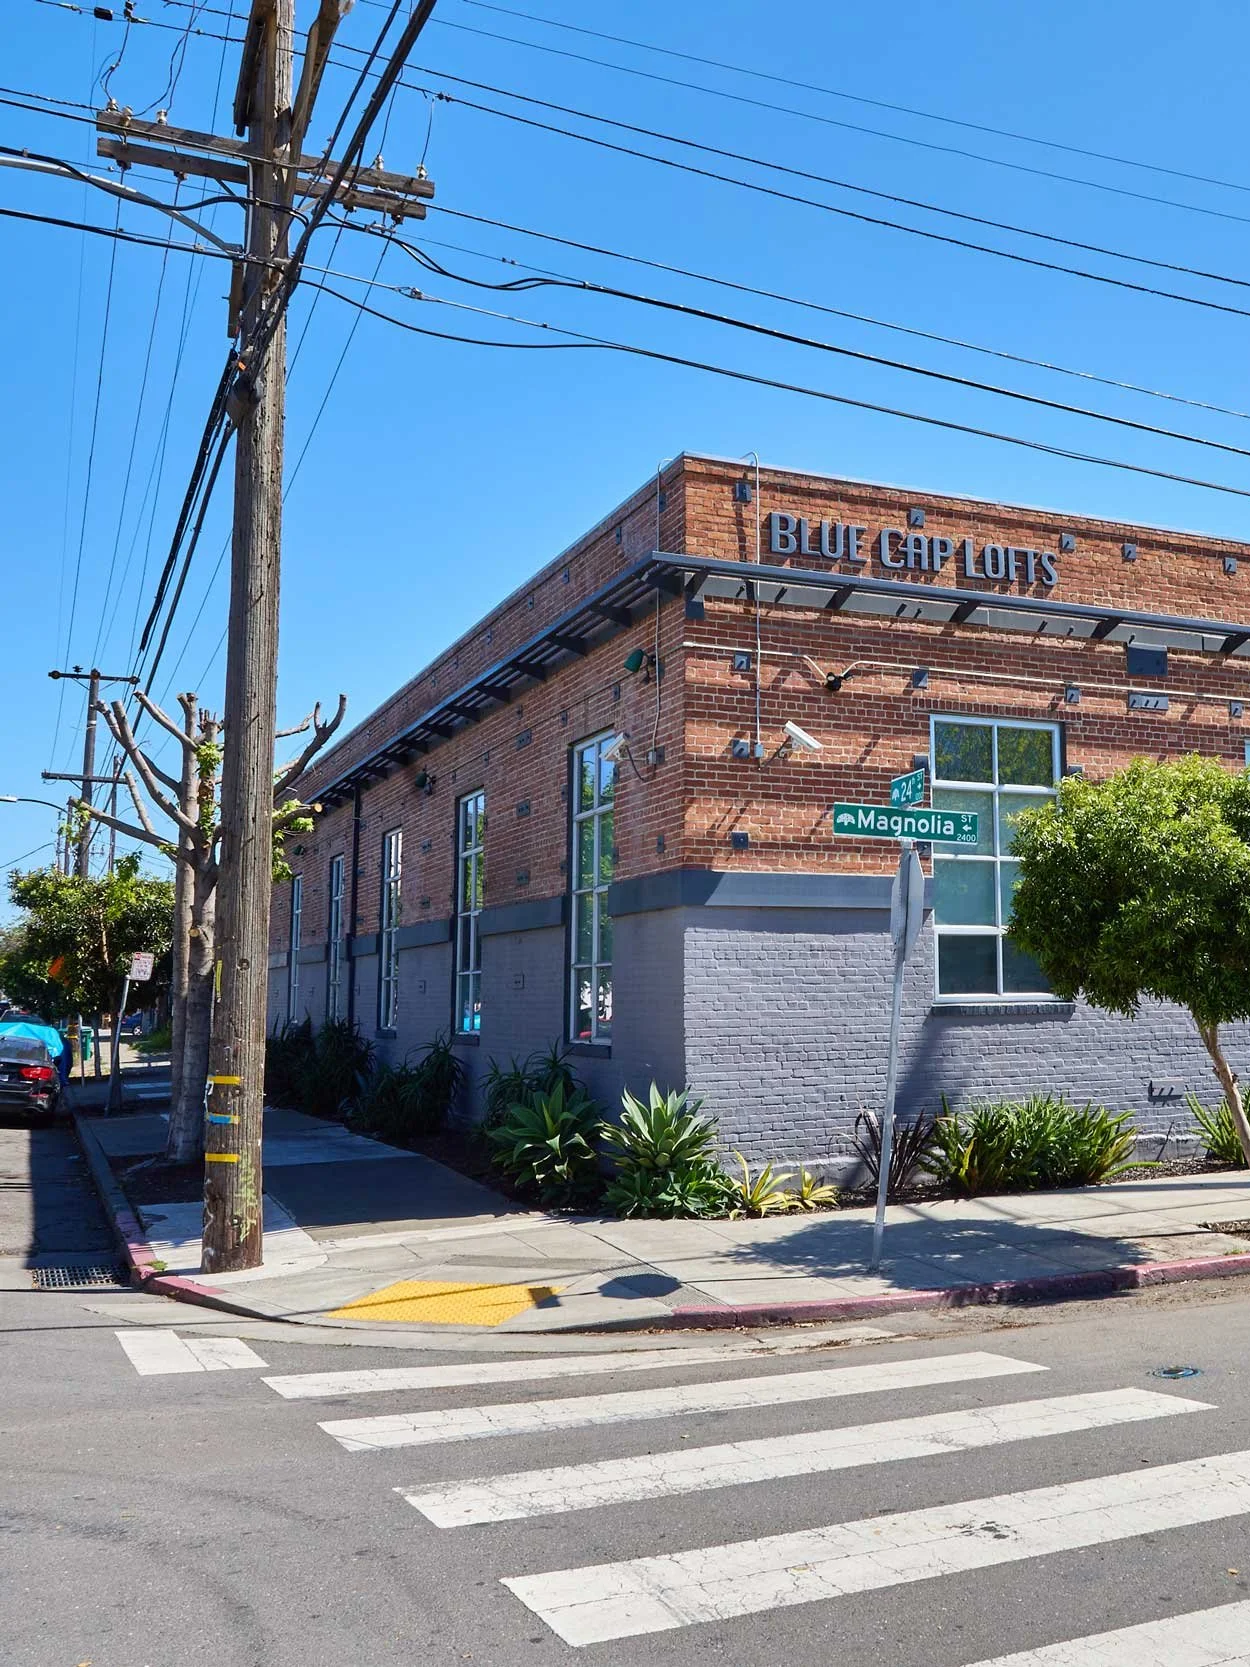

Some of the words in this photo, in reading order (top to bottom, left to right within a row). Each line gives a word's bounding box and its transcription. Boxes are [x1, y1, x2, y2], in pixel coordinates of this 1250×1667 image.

[769, 512, 869, 562] BLUE
[879, 528, 954, 572] CAP
[964, 538, 1059, 586] LOFTS
[857, 809, 954, 836] Magnolia
[961, 814, 973, 823] ST
[956, 833, 976, 842] 2400
